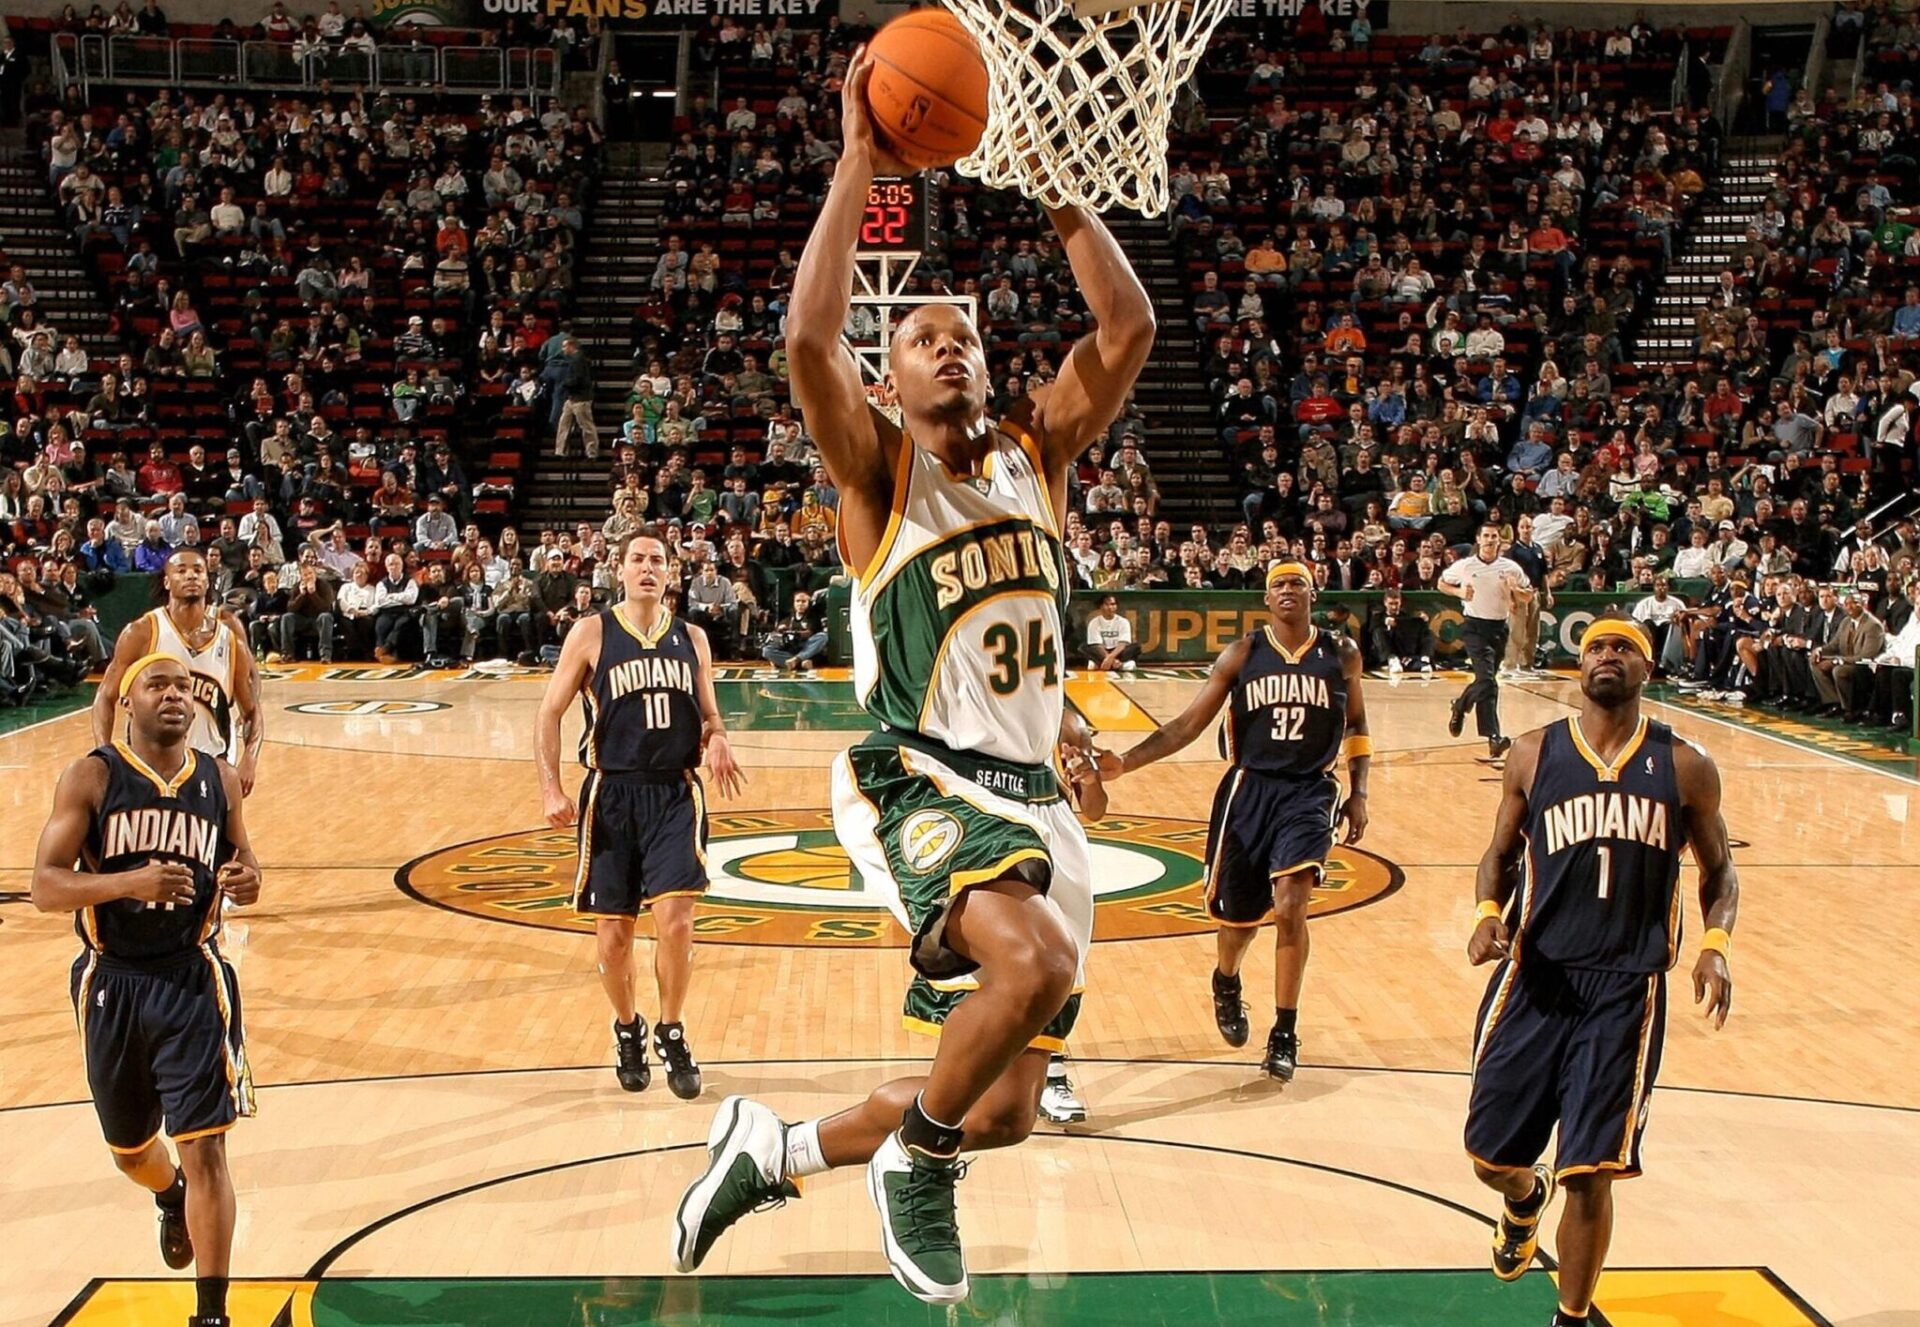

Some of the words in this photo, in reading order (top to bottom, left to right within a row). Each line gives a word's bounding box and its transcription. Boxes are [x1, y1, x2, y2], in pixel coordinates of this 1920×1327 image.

[483, 0, 538, 13] OUR
[547, 0, 647, 19] FANS
[653, 0, 707, 15] ARE
[715, 0, 761, 14] THE
[768, 0, 820, 14] KEY
[868, 185, 913, 204] 6:05
[863, 206, 906, 243] 22
[983, 619, 1058, 695] 34
[608, 657, 694, 701] INDIANA
[1245, 674, 1330, 712] INDIANA
[642, 692, 672, 730] 10
[1270, 707, 1306, 741] 32
[975, 769, 1025, 794] SEATTLE
[105, 808, 219, 873] INDIANA
[1543, 792, 1668, 856] INDIANA
[1596, 845, 1611, 899] 1
